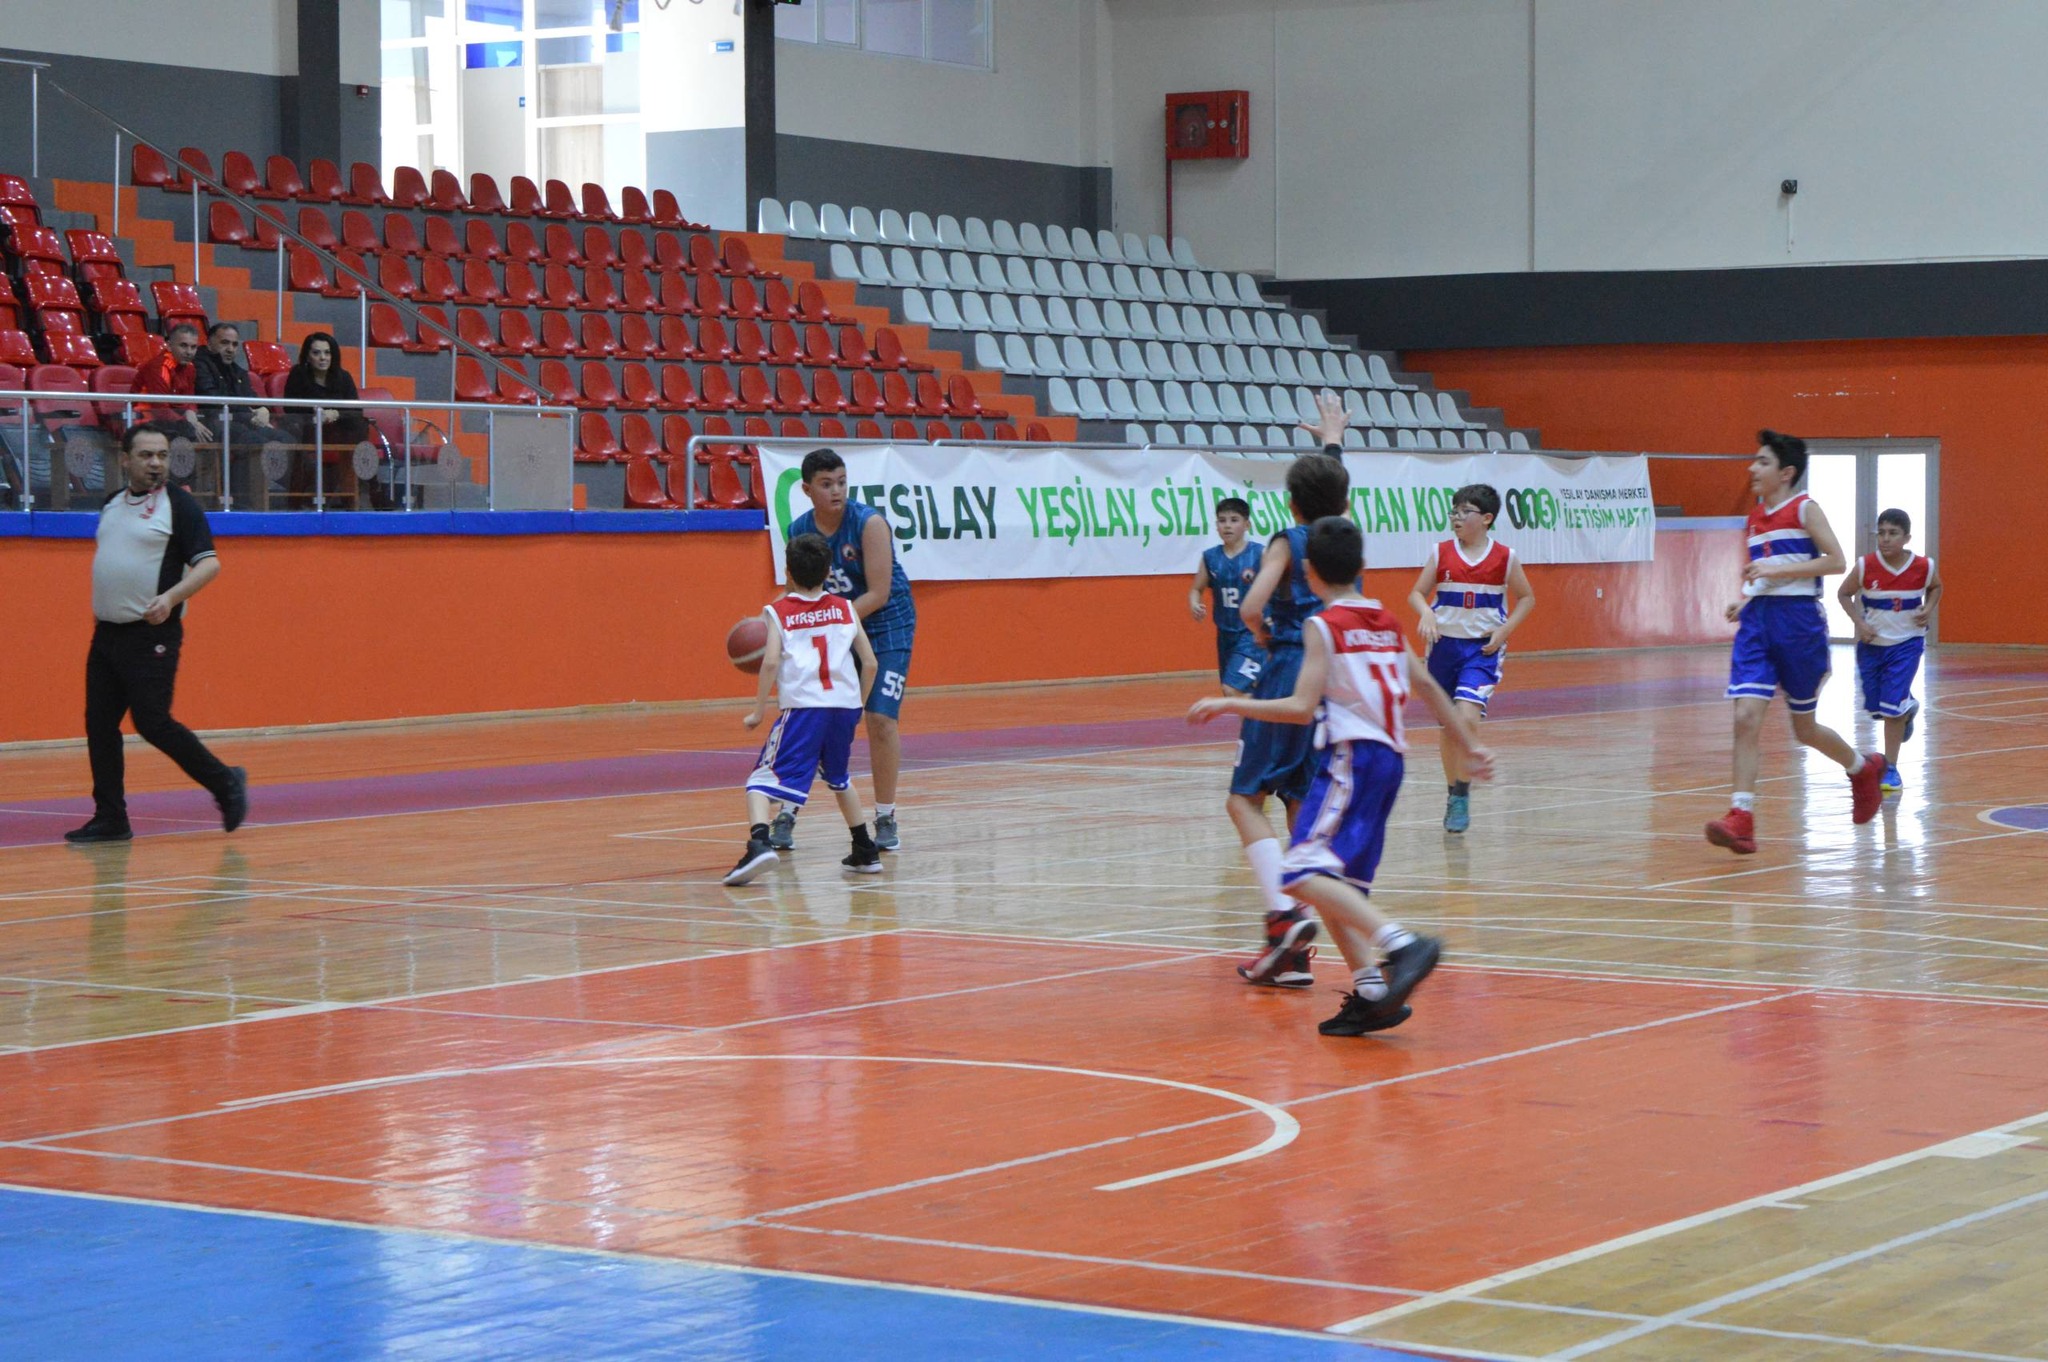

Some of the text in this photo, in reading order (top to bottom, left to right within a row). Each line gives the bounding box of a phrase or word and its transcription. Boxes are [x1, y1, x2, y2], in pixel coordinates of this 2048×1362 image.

[1016, 476, 1150, 547] YEŞİLAY,
[1151, 476, 1208, 536] SİZİ
[825, 567, 853, 594] 55
[1221, 587, 1240, 608] 12
[1463, 591, 1476, 609] 0
[811, 633, 834, 692] 1
[1238, 657, 1262, 681] 12
[881, 670, 906, 701] 55
